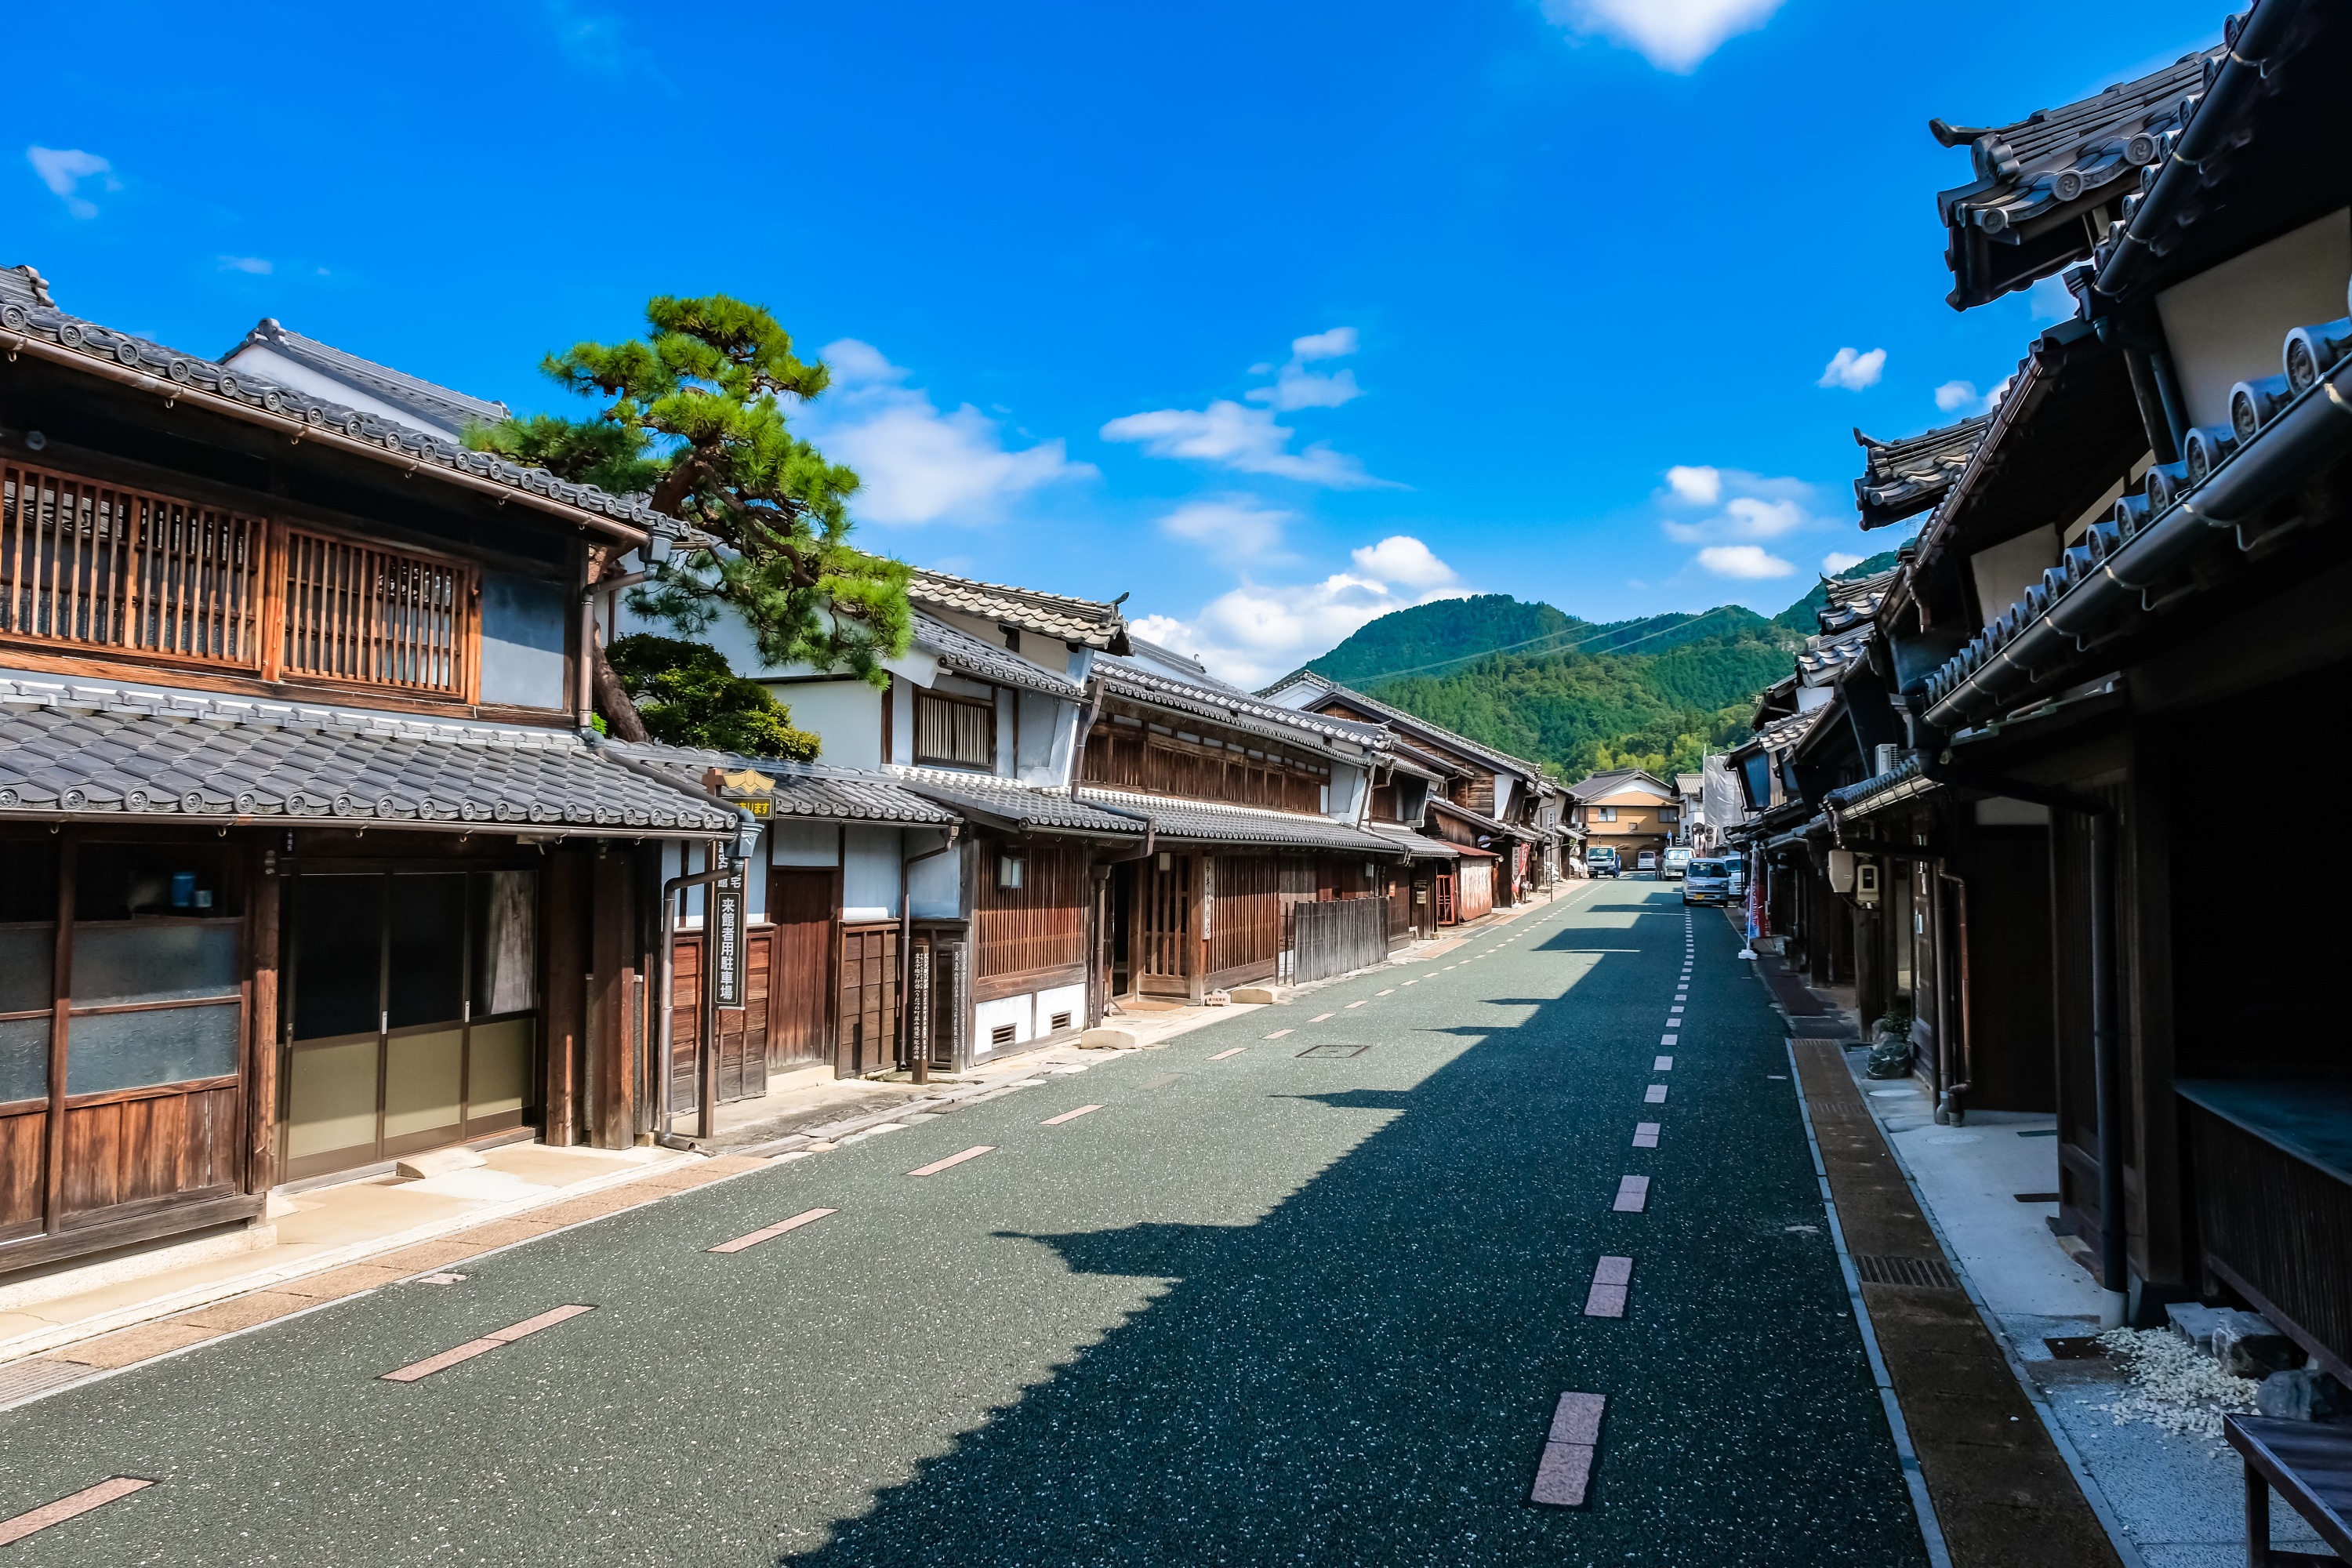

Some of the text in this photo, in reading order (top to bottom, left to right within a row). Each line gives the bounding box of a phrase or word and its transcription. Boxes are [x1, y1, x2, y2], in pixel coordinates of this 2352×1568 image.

[720, 898, 735, 1000] 来館者用駐車場
